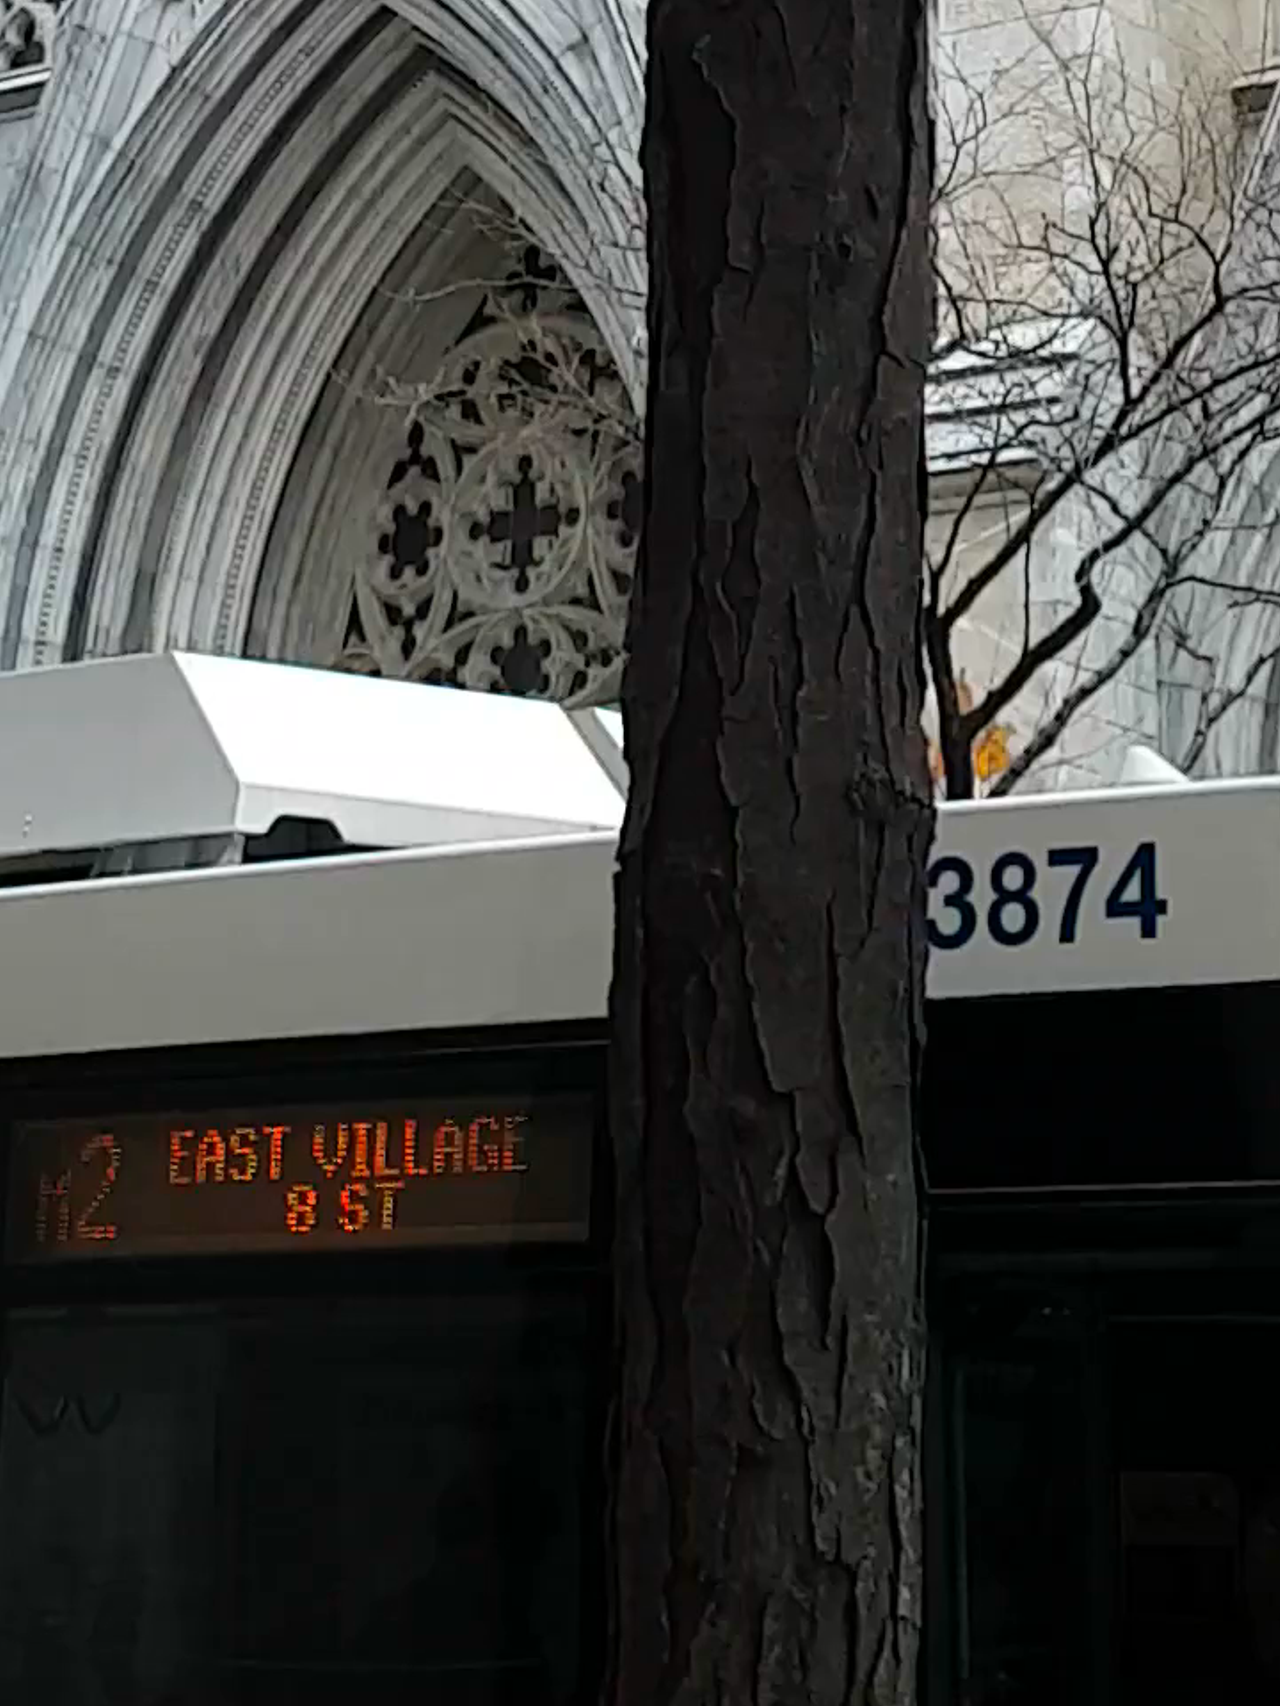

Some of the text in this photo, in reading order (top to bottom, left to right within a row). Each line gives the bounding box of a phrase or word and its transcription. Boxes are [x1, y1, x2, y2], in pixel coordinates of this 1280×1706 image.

[926, 841, 1168, 950] 3874
[169, 1115, 530, 1185] EAST VILLAGE
[285, 1180, 408, 1236] 8 ST
